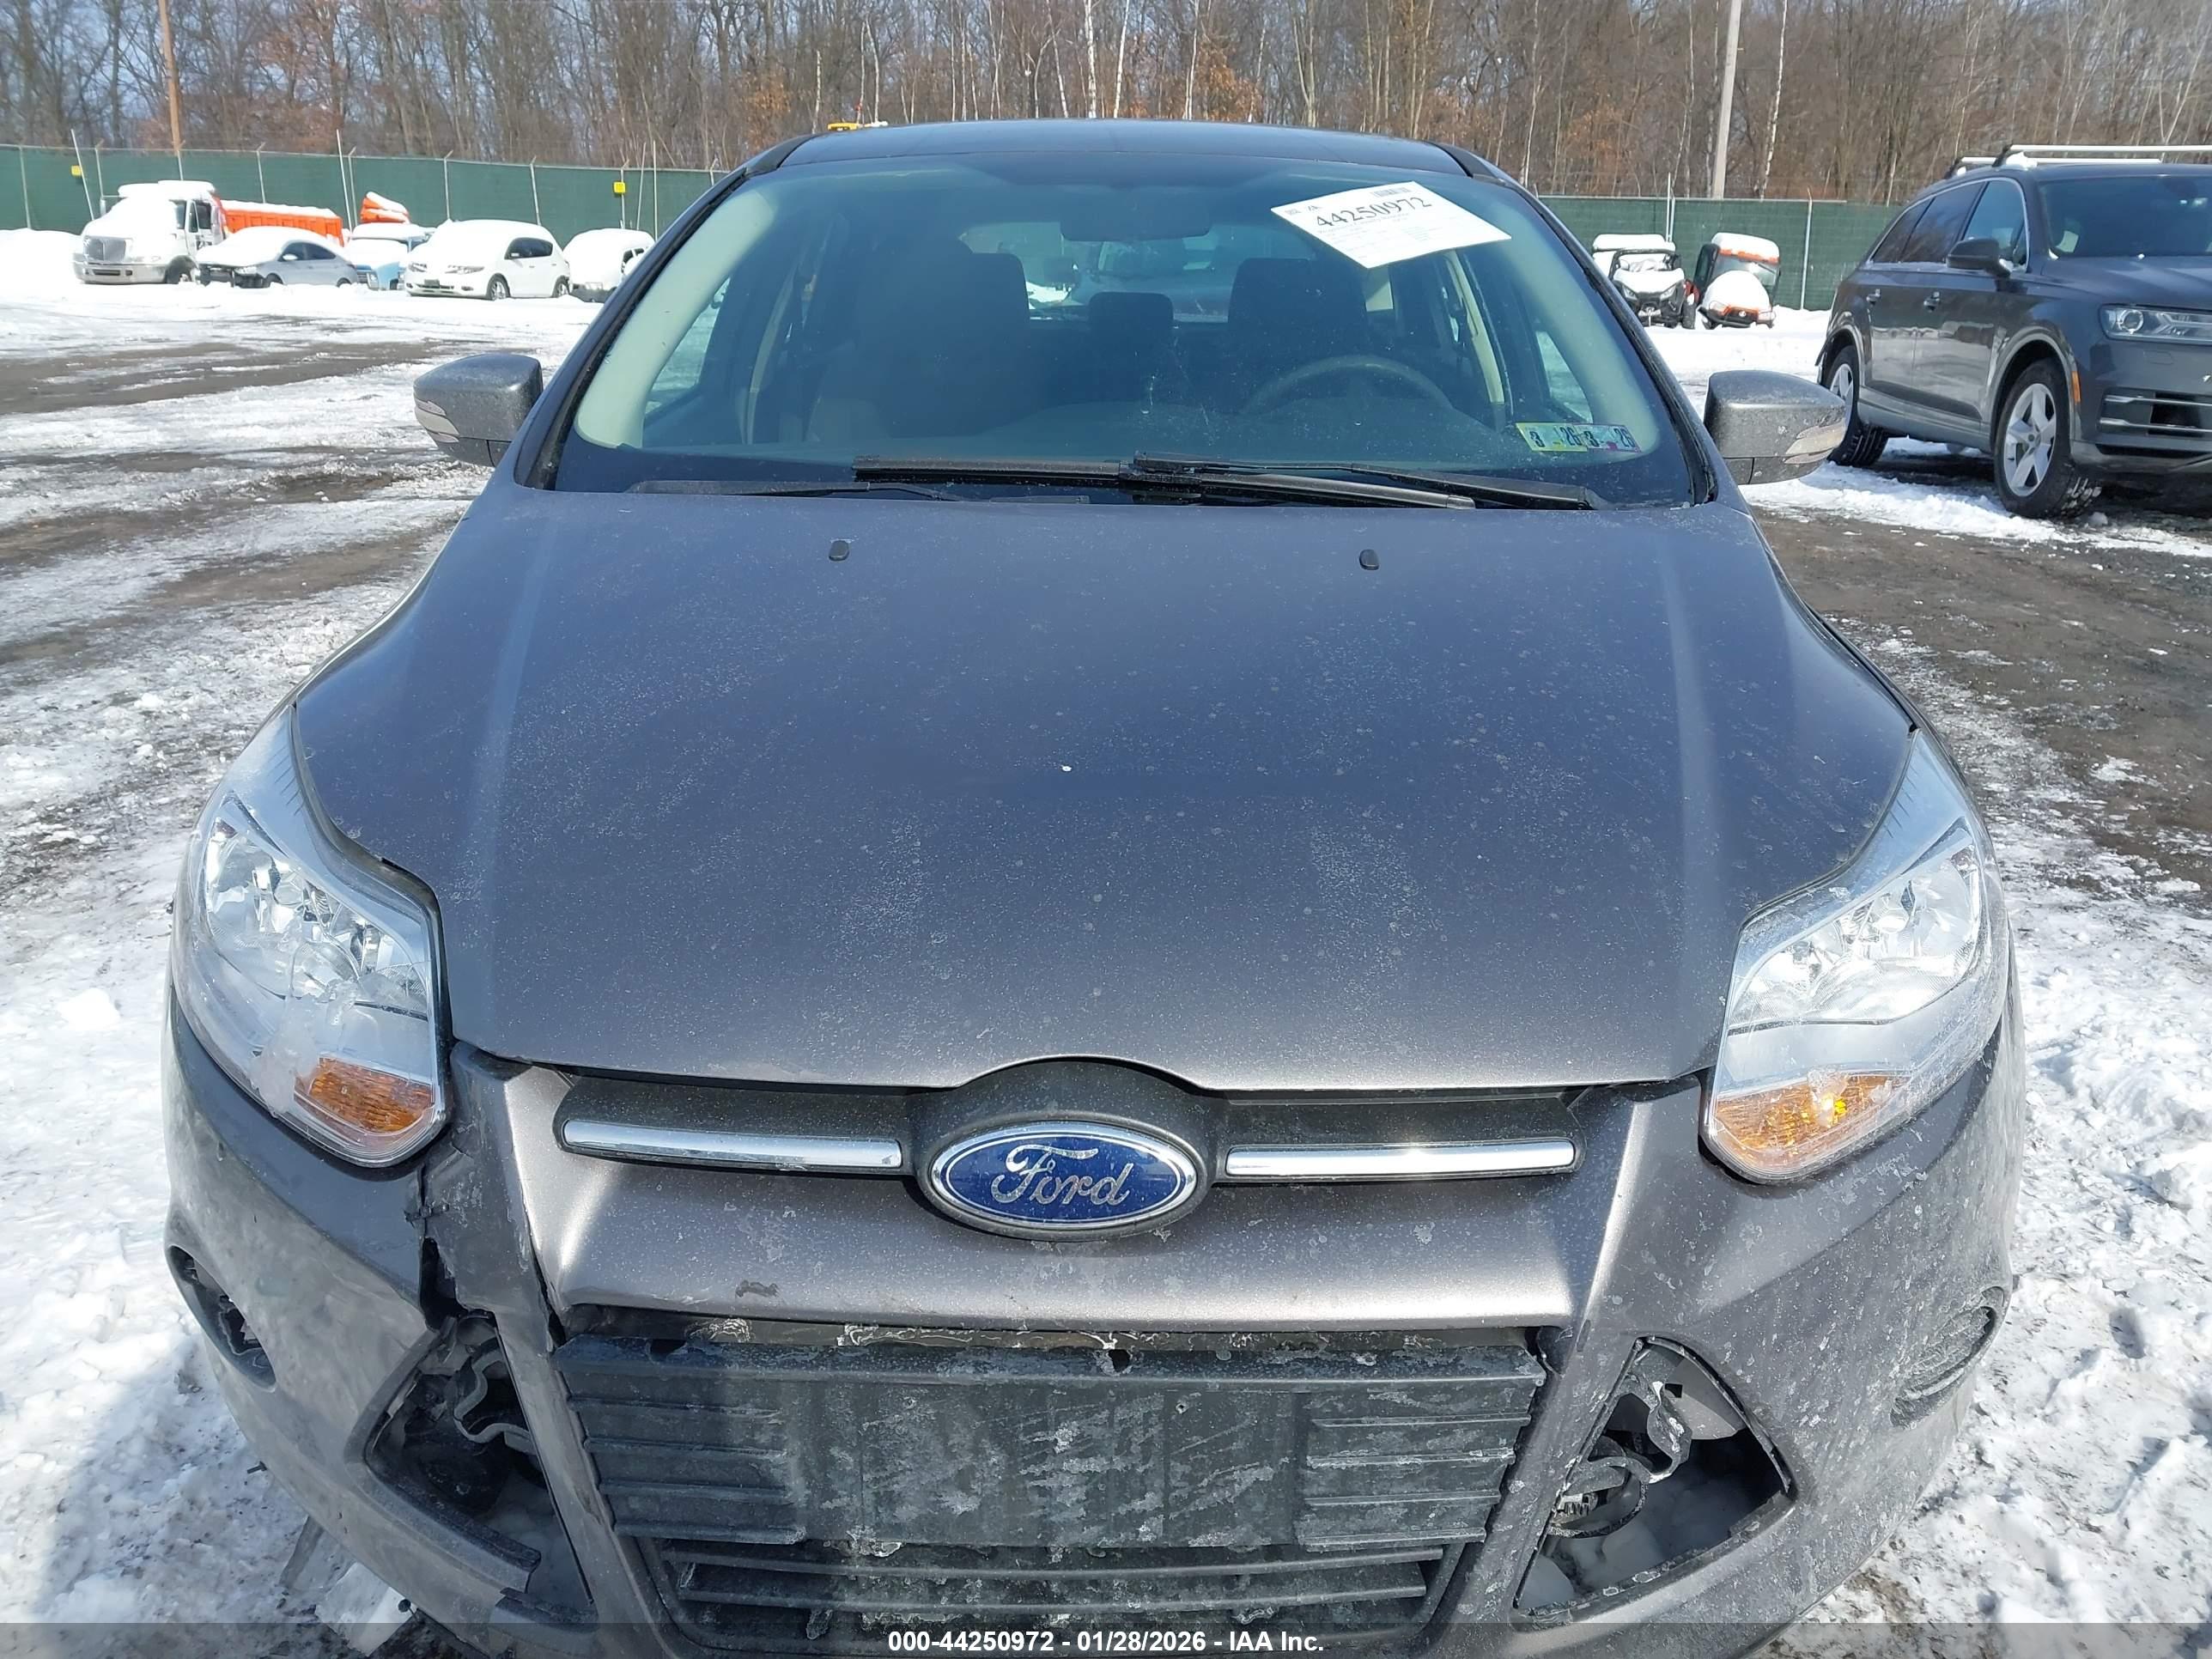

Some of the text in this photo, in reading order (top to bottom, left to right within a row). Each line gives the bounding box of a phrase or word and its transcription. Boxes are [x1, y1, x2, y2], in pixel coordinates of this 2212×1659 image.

[1316, 197, 1432, 227] 44250972
[1529, 427, 1583, 447] 3 26
[1613, 428, 1636, 447] 26
[991, 1144, 1133, 1204] Ford
